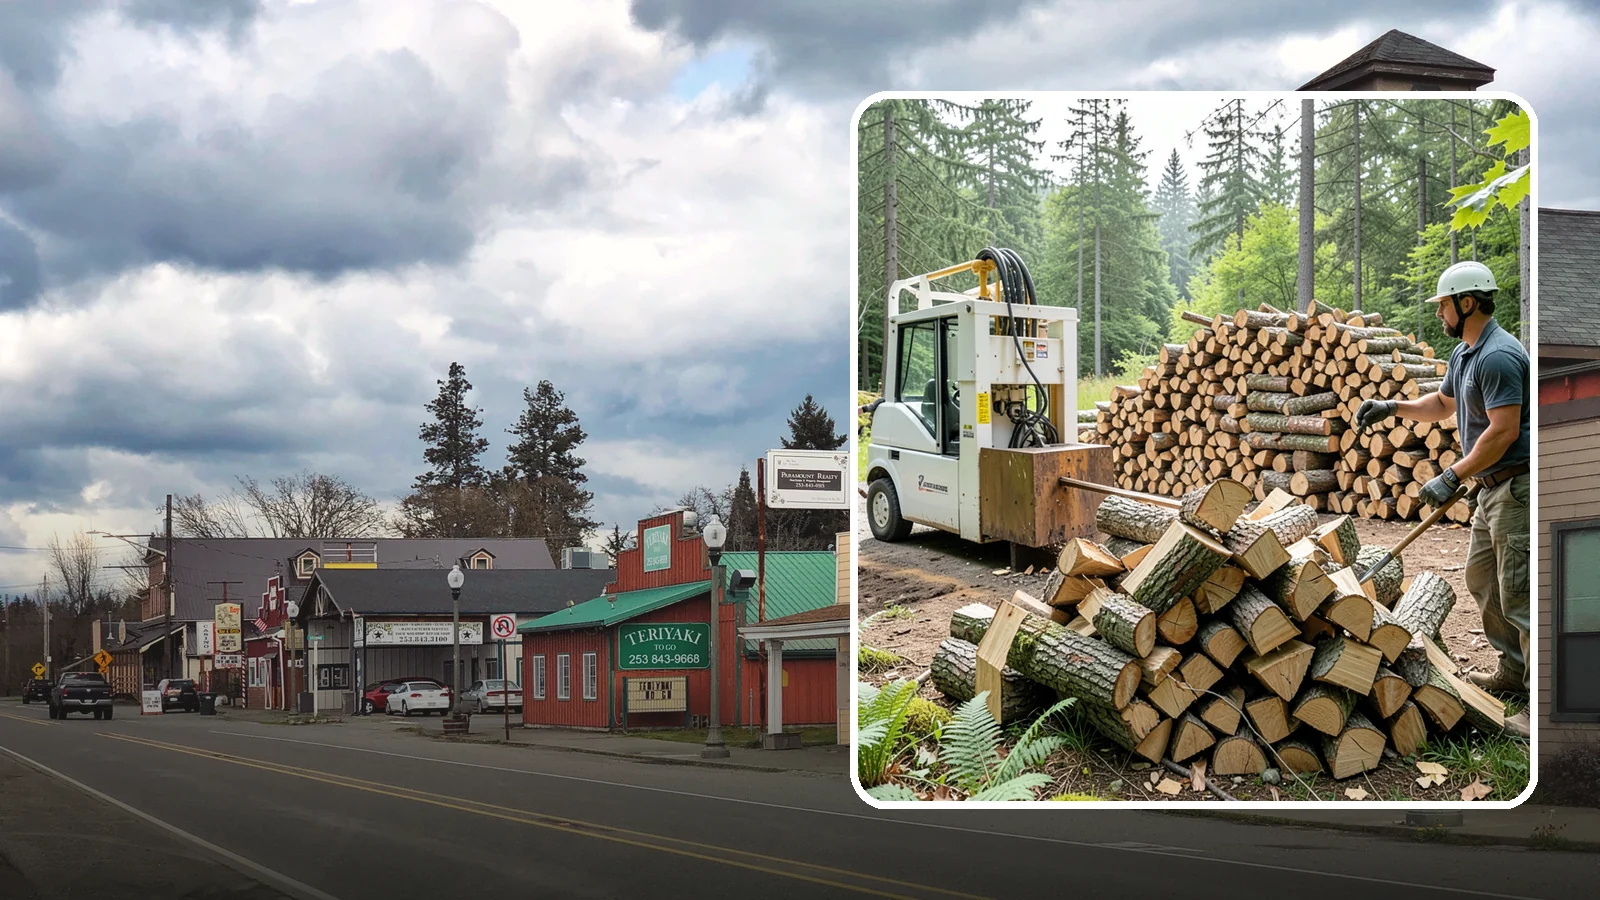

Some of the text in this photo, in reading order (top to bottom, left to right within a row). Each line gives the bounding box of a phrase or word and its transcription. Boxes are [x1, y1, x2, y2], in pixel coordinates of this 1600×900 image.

[781, 471, 838, 480] PARAMOUNT REALTY
[624, 627, 702, 646] TERIYAKI
[653, 643, 677, 651] TO GO
[628, 653, 700, 665] 253 843-9668
[639, 681, 673, 690] TERIYAKI
